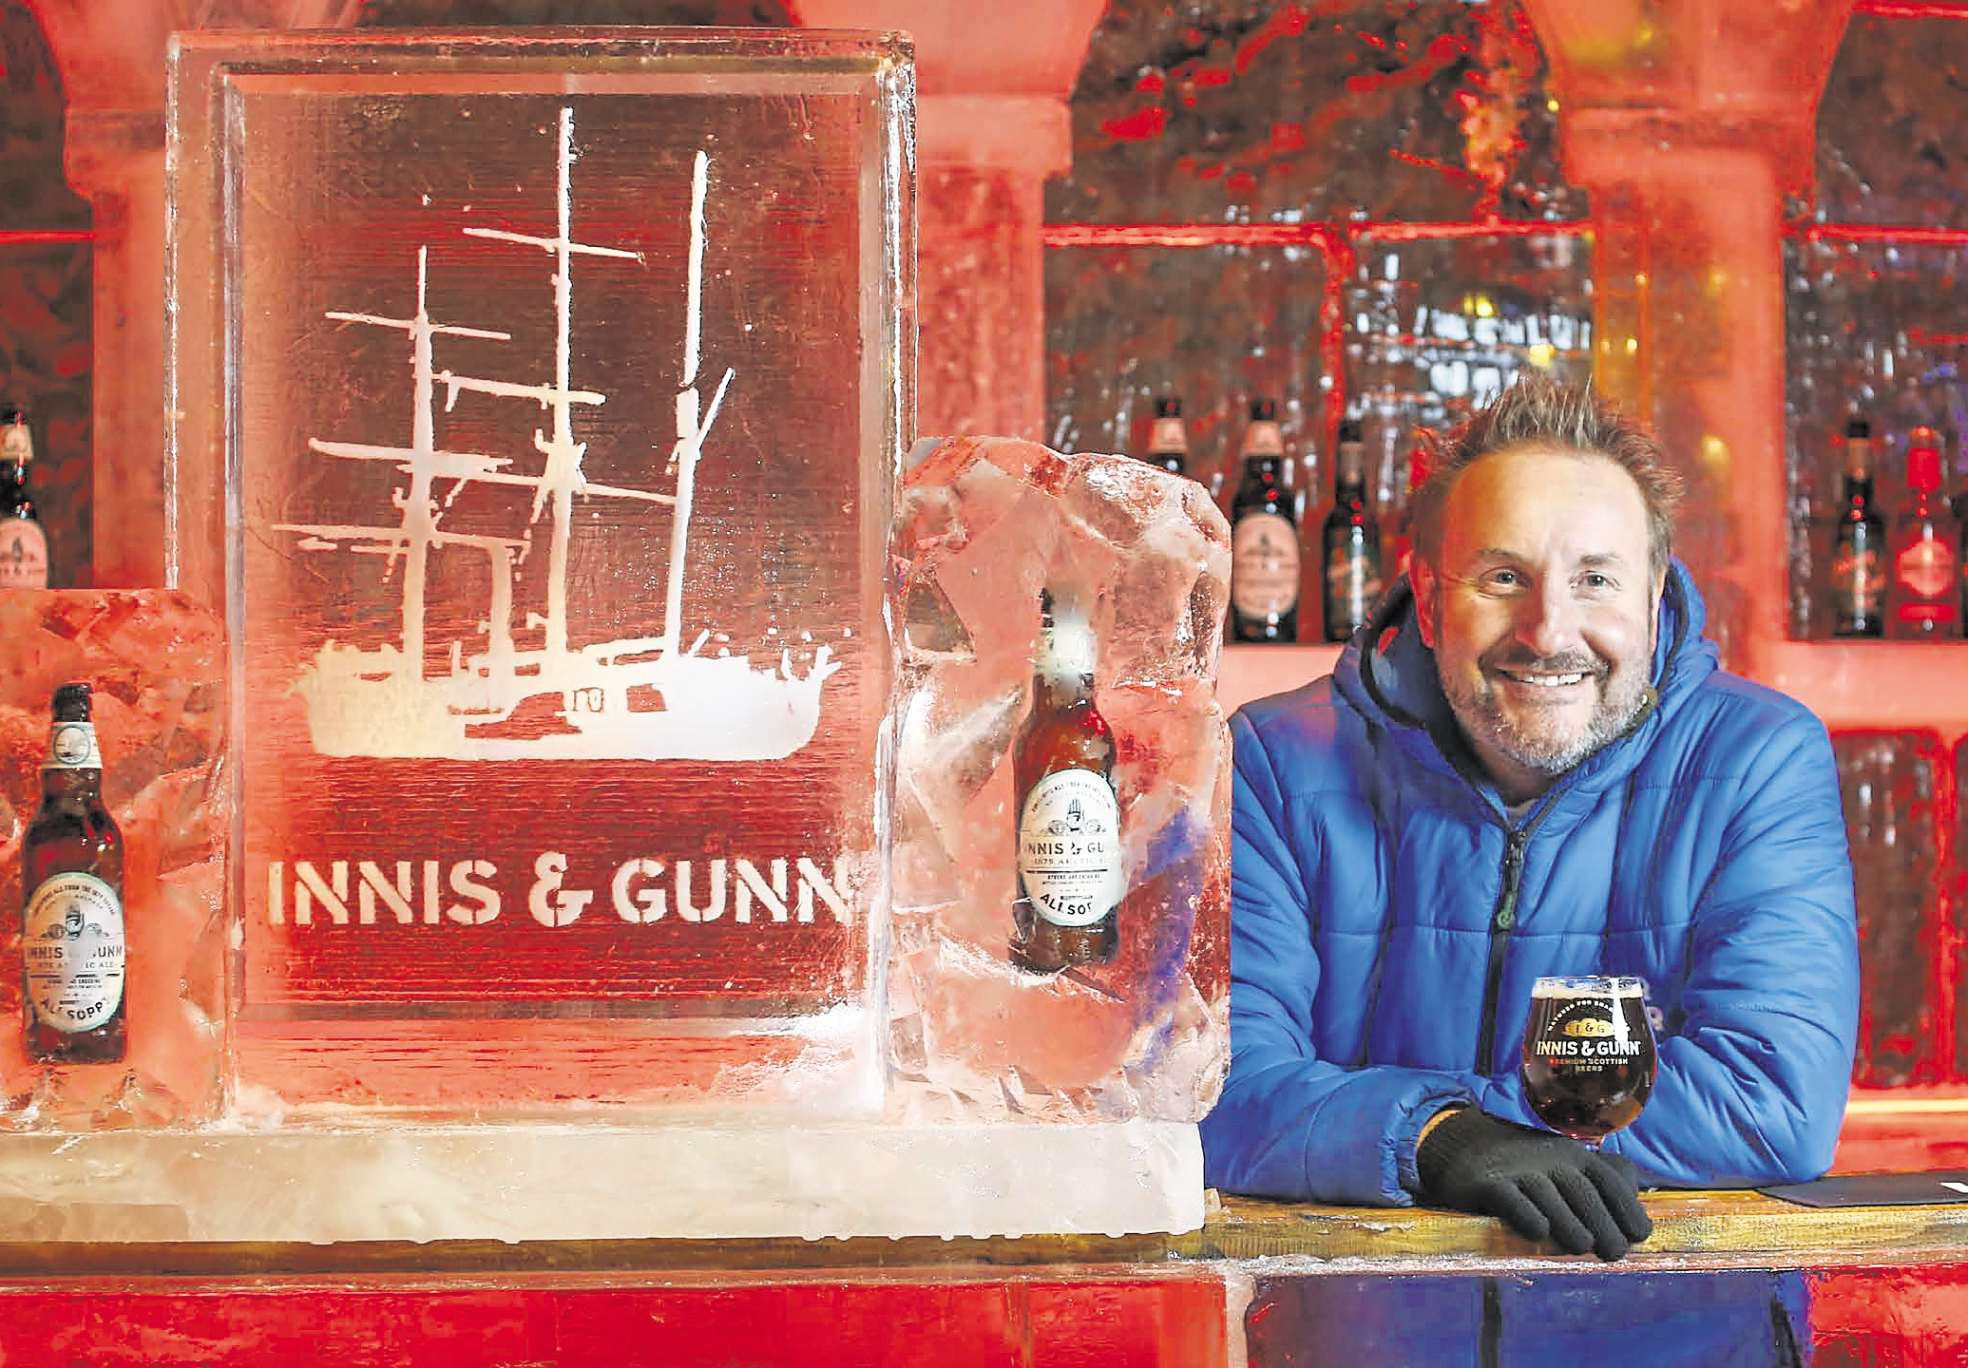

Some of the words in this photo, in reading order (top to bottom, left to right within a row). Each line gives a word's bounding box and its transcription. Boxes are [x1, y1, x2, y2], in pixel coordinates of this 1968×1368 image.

[1028, 842, 1064, 855] NNIS
[266, 859, 502, 925] INNIS
[528, 851, 594, 927] &
[611, 858, 855, 926] GUNN
[92, 945, 123, 958] UNN
[1536, 1040, 1578, 1056] INNIS
[1580, 1040, 1596, 1057] &
[1596, 1041, 1641, 1056] GUNN
